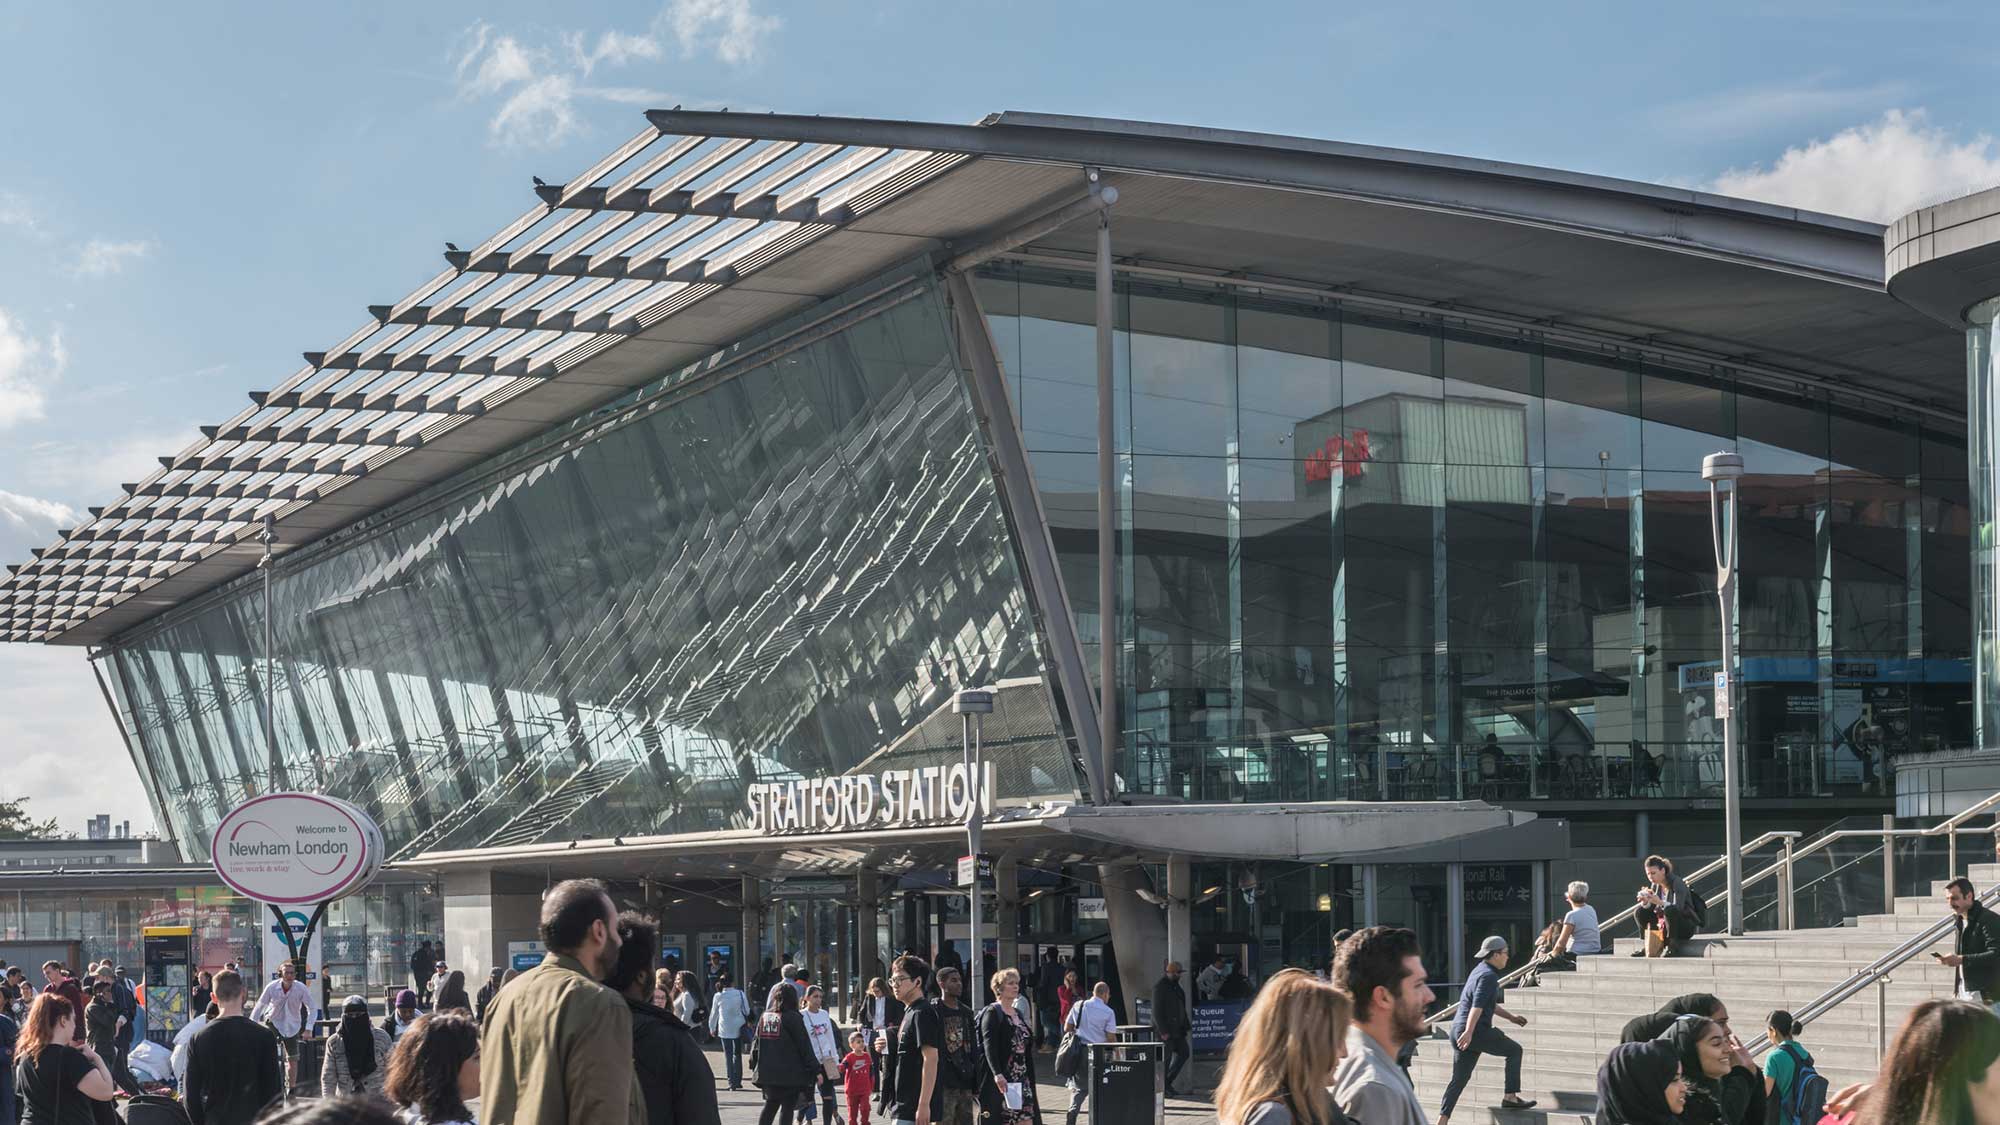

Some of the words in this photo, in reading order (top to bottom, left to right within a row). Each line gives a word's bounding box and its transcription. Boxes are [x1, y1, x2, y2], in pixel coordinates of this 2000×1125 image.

[747, 773, 878, 831] STRATFORD
[881, 761, 990, 823] STATION
[296, 825, 336, 834] Welcome
[338, 824, 348, 833] to
[229, 840, 291, 857] Newham
[296, 839, 348, 855] London
[1477, 886, 1505, 901] office
[1200, 1008, 1225, 1016] queue
